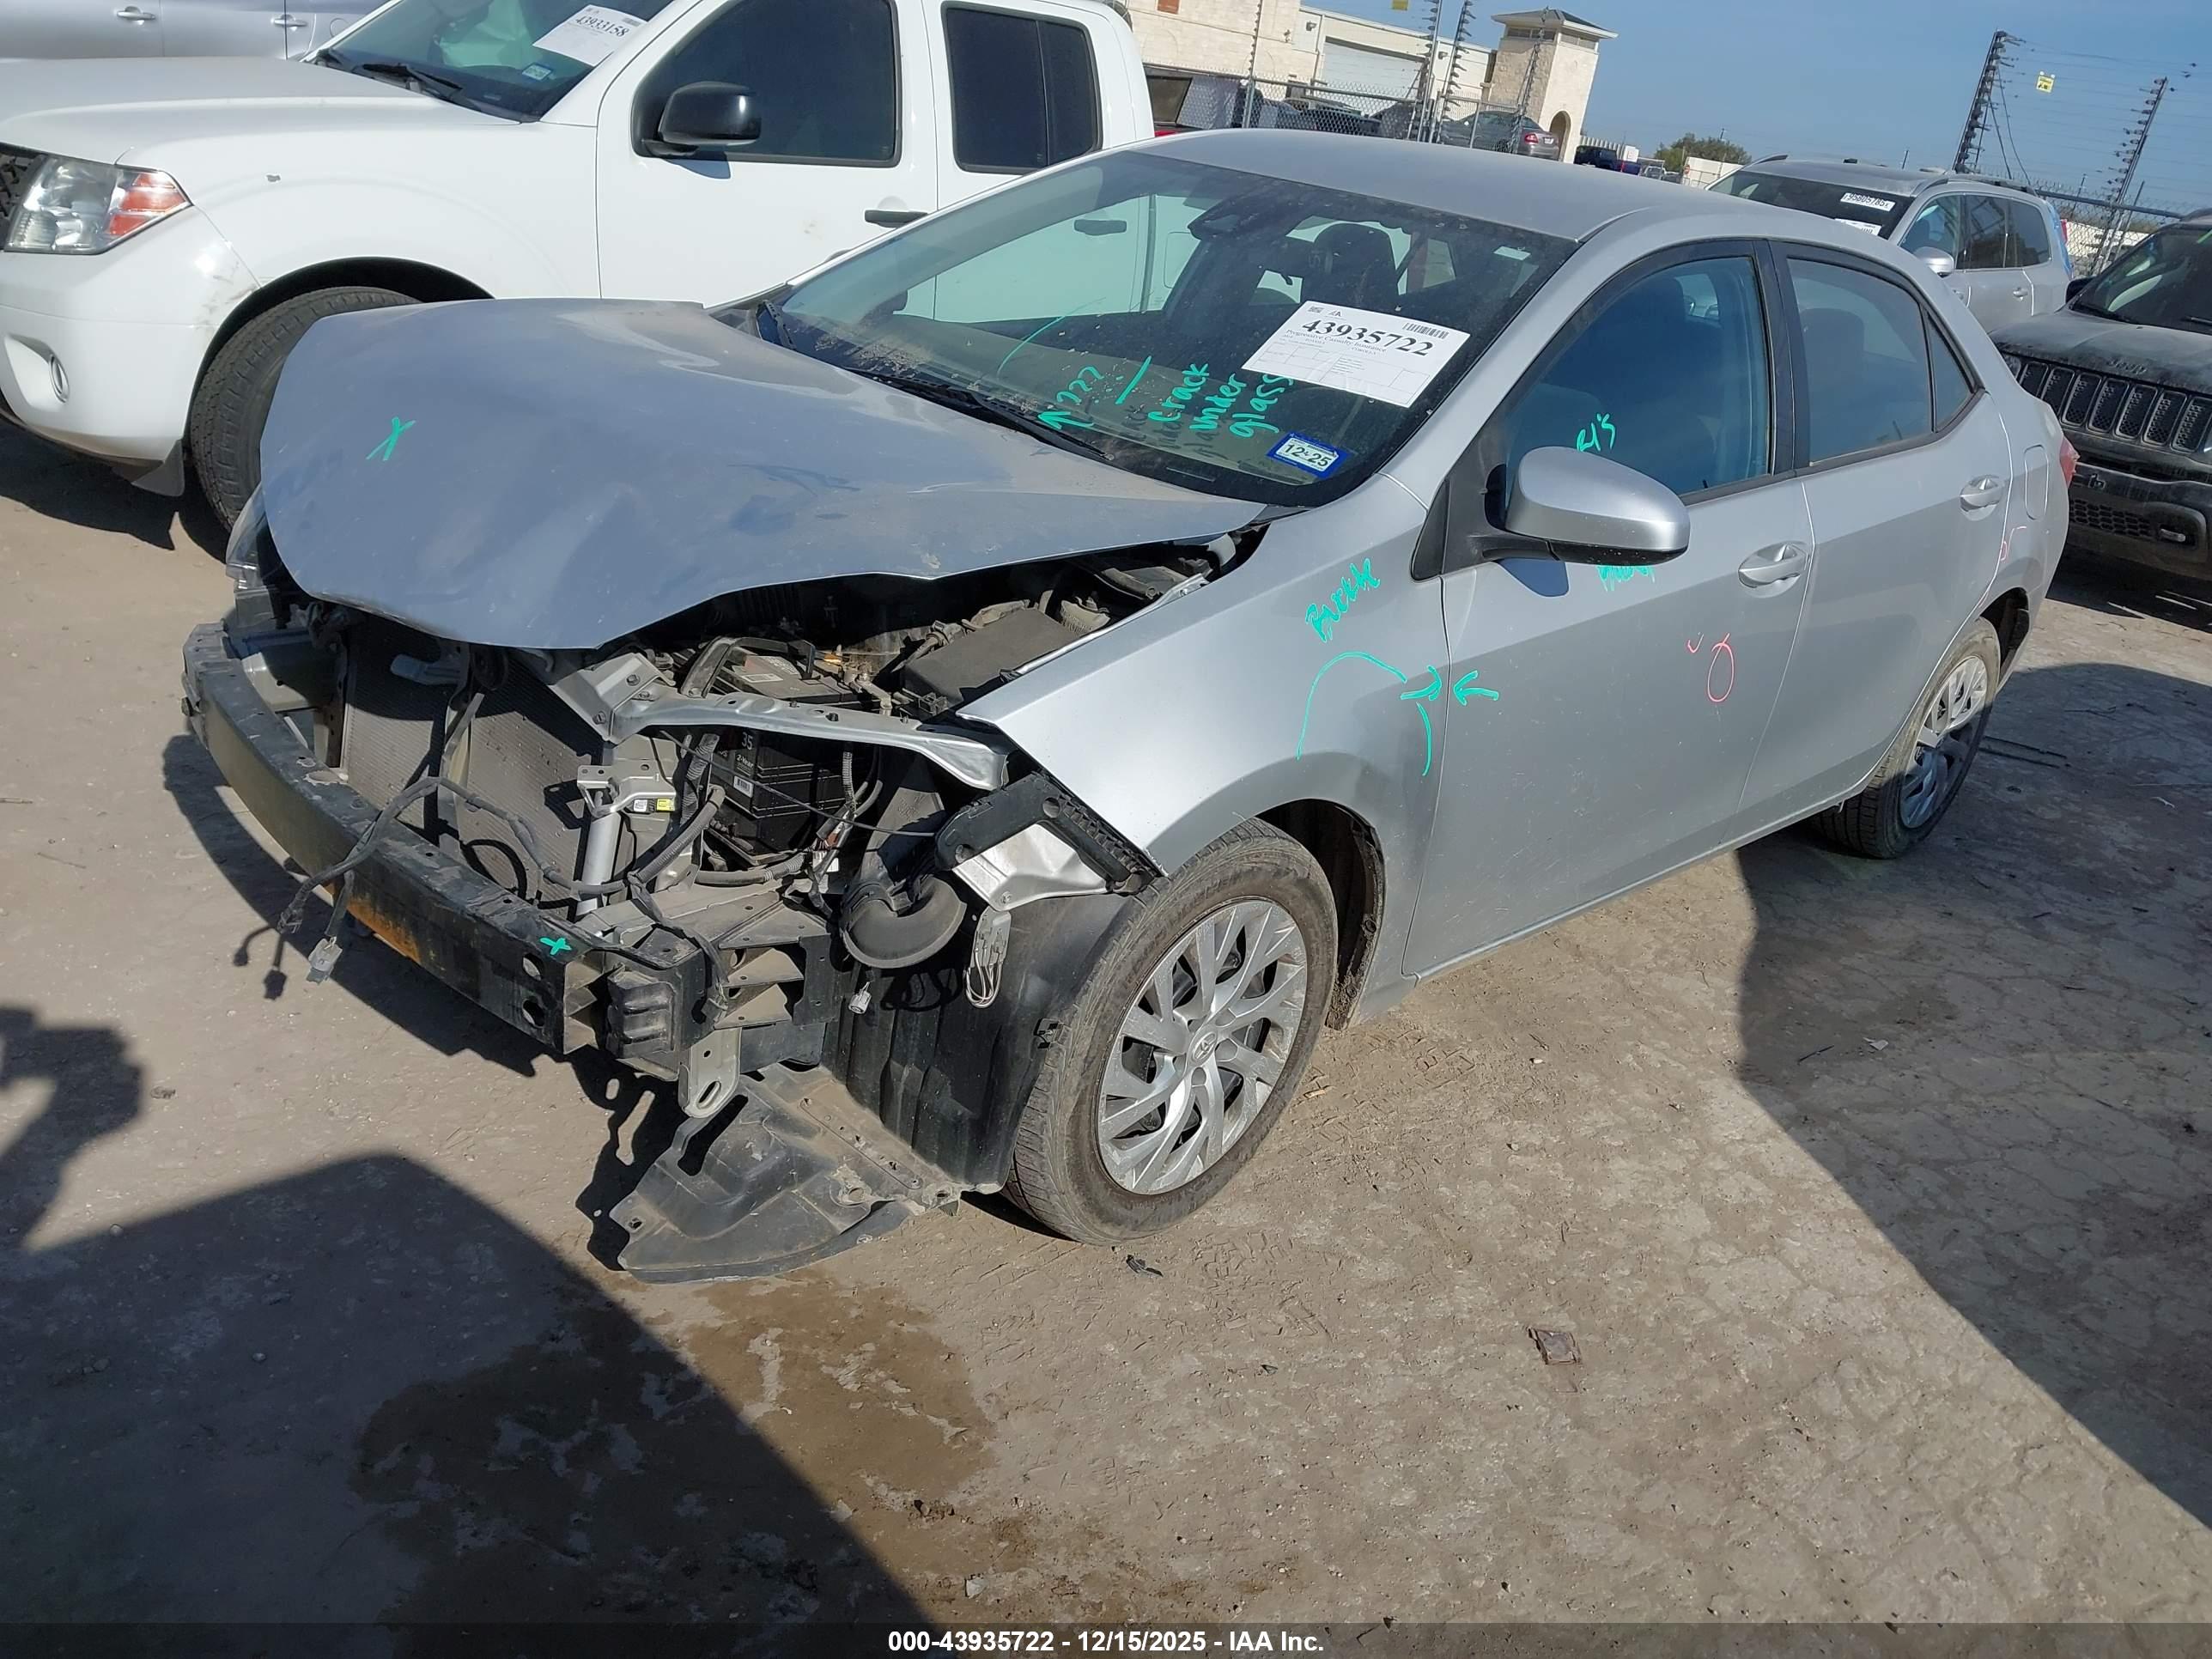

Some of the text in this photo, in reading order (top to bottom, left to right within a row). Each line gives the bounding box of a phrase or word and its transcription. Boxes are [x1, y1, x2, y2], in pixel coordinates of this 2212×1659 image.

[575, 15, 630, 37] 43933158
[1302, 319, 1434, 356] 43935722
[741, 732, 753, 750] 35
